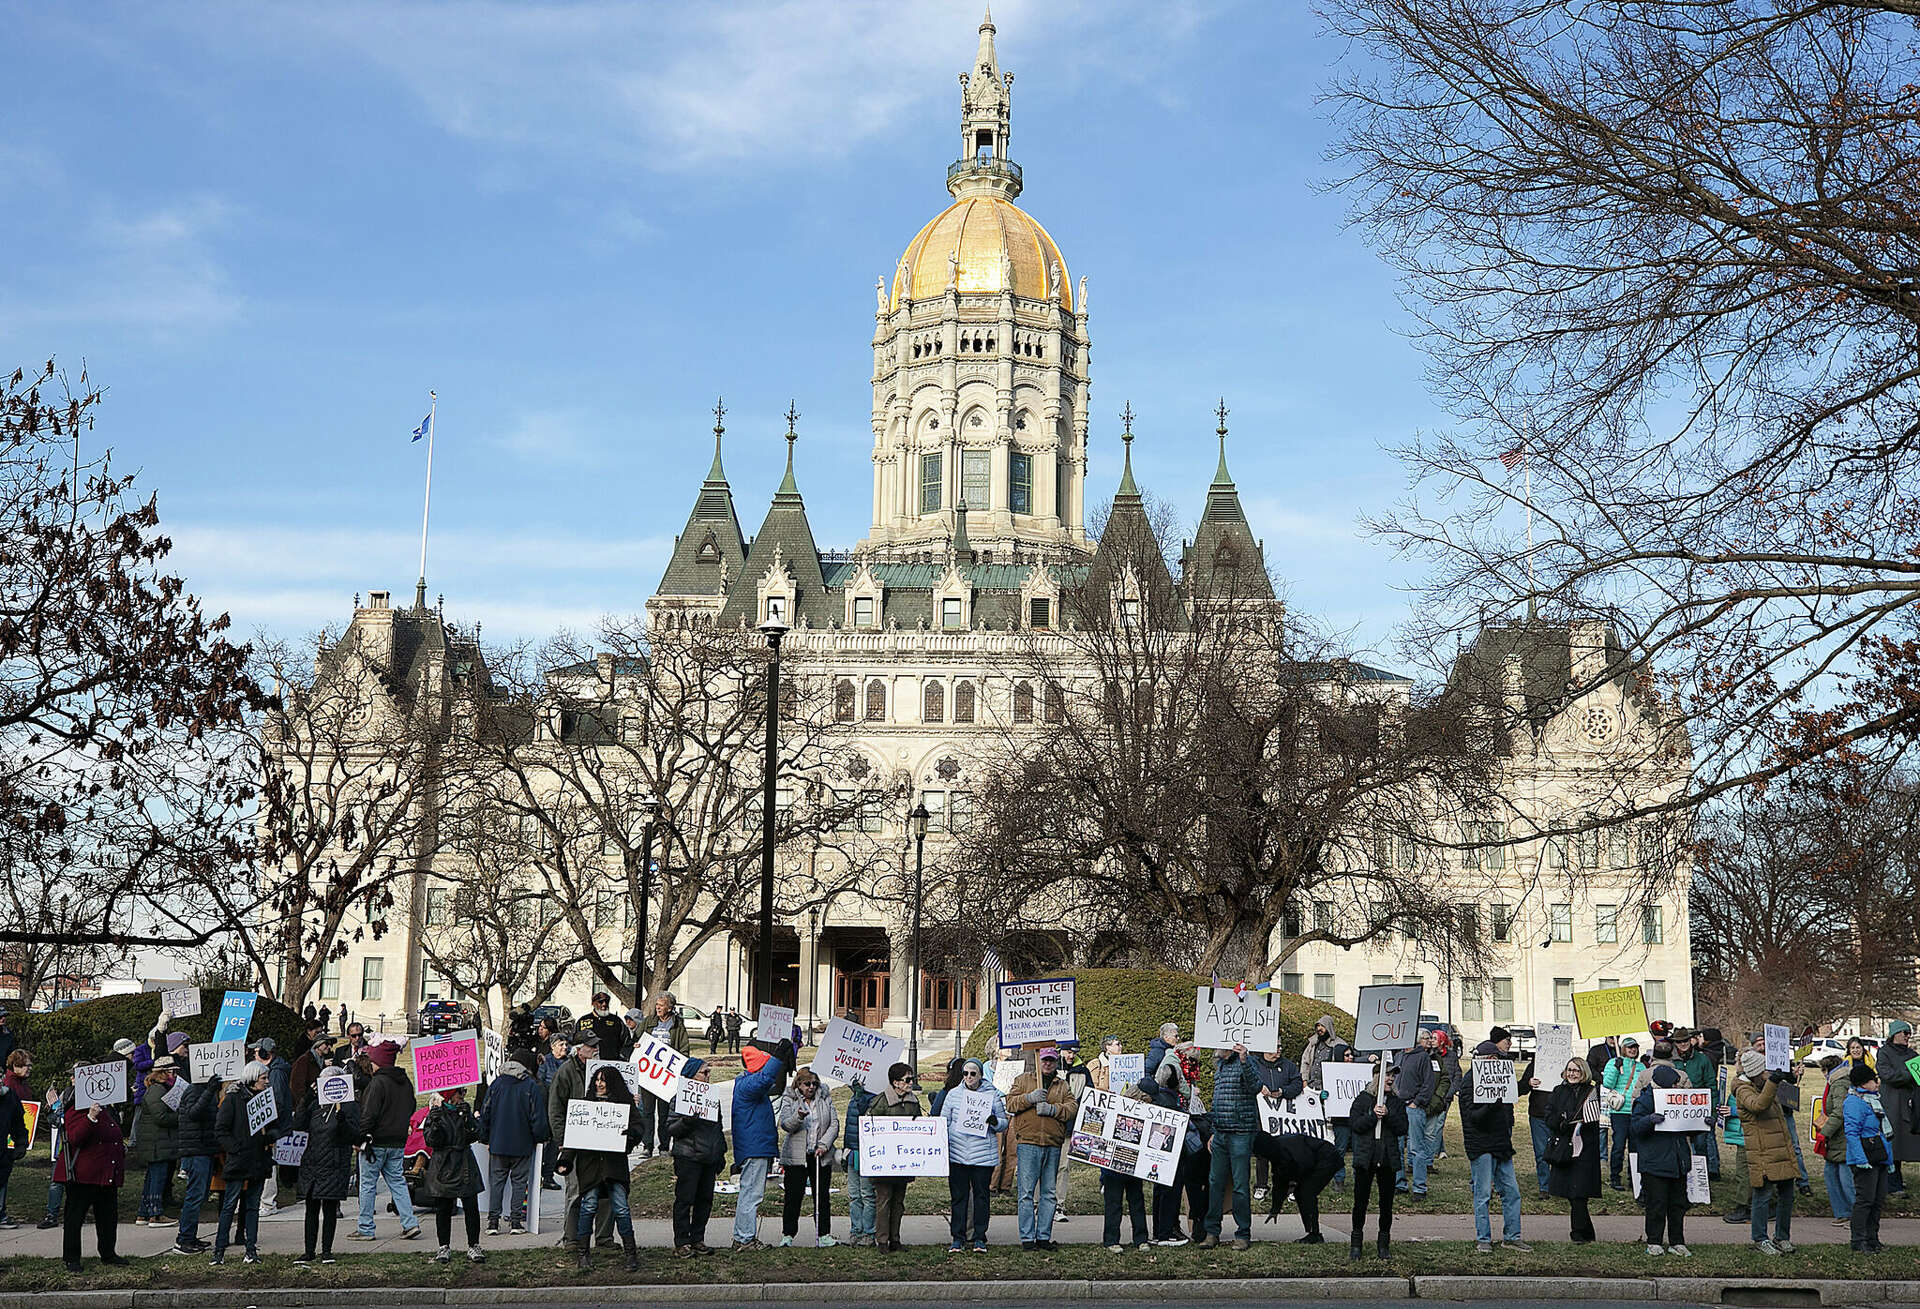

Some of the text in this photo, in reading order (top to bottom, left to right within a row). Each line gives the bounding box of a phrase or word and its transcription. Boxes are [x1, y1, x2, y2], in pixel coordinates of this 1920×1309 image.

[167, 990, 192, 1000] ICE
[1005, 983, 1070, 996] CRUSH ICE!
[168, 1000, 188, 1008] OUT
[224, 998, 255, 1007] MELT
[1009, 995, 1061, 1007] NOT THE
[1377, 998, 1408, 1015] ICE
[1009, 1006, 1069, 1020] INNOCENT!
[1206, 1004, 1275, 1027] ABOLISH
[1589, 1002, 1636, 1018] IMPEACH
[225, 1017, 246, 1026] ICE
[1220, 1027, 1252, 1044] ICE
[1372, 1021, 1408, 1040] OUT
[842, 1026, 888, 1052] LIBERTY
[195, 1041, 239, 1060] Abolish
[420, 1045, 470, 1061] HANDS OFF
[645, 1042, 680, 1073] ICE
[422, 1058, 471, 1075] PEACEFUL
[835, 1048, 872, 1072] JUSTICE
[1474, 1060, 1514, 1075] VETERAN
[78, 1062, 123, 1078] ABOLISH
[199, 1061, 235, 1078] ICE
[638, 1057, 676, 1086] OUT
[831, 1066, 866, 1086] FOR ALL
[91, 1078, 111, 1093] ICE
[423, 1071, 471, 1090] PROTESTS
[688, 1081, 709, 1093] STOP
[1480, 1074, 1511, 1084] AGAINST
[682, 1089, 703, 1105] ICE
[1263, 1095, 1296, 1114] WE
[1667, 1093, 1709, 1105] ICE OUT
[569, 1104, 588, 1113] ICE
[596, 1105, 622, 1118] Melts
[1082, 1089, 1189, 1128] ARE WE SAFE?
[1664, 1108, 1709, 1120] FOR GOOD
[250, 1107, 273, 1130] GOOD
[963, 1120, 984, 1131] GOOD
[1268, 1116, 1325, 1139] DISSENT
[283, 1134, 307, 1147] ICE
[869, 1145, 886, 1158] End
